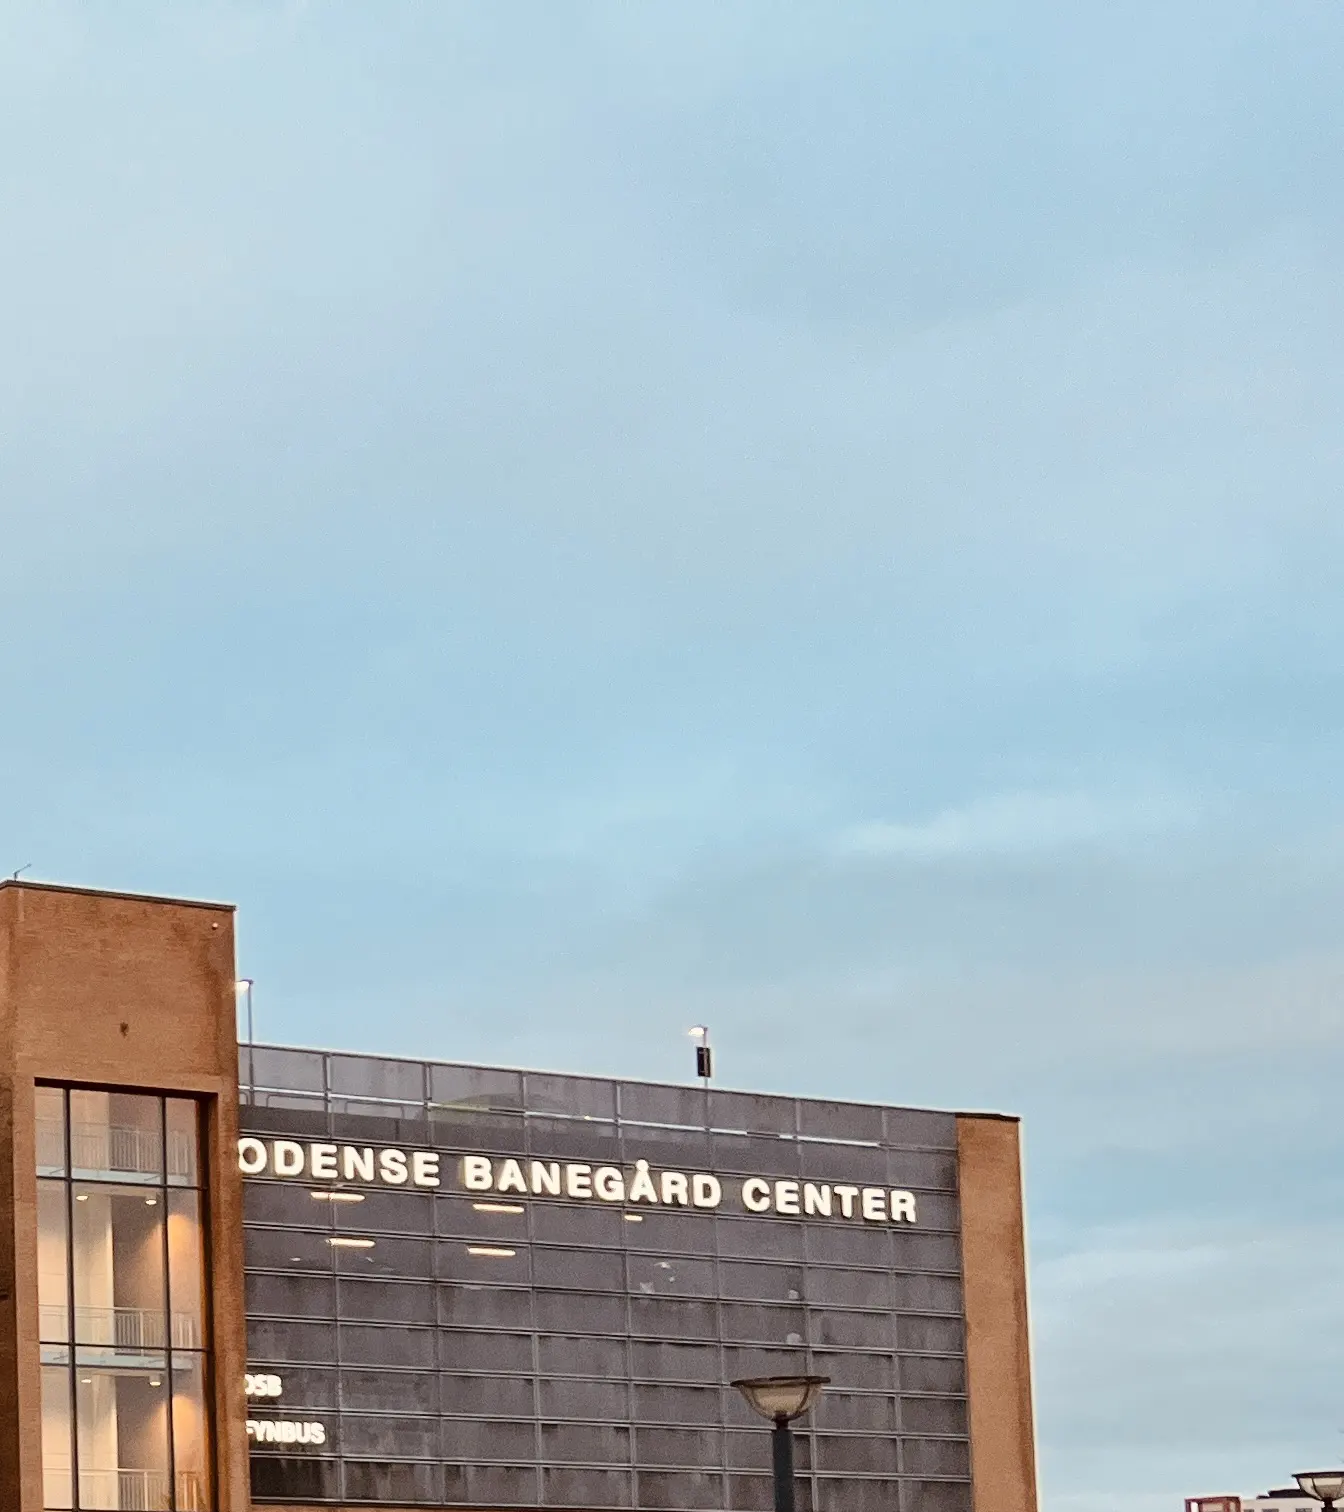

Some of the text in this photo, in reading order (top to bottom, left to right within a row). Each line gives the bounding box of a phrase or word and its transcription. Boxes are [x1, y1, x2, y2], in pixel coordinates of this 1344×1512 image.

[237, 1137, 916, 1223] ODENSE BANEGÅRD CENTER
